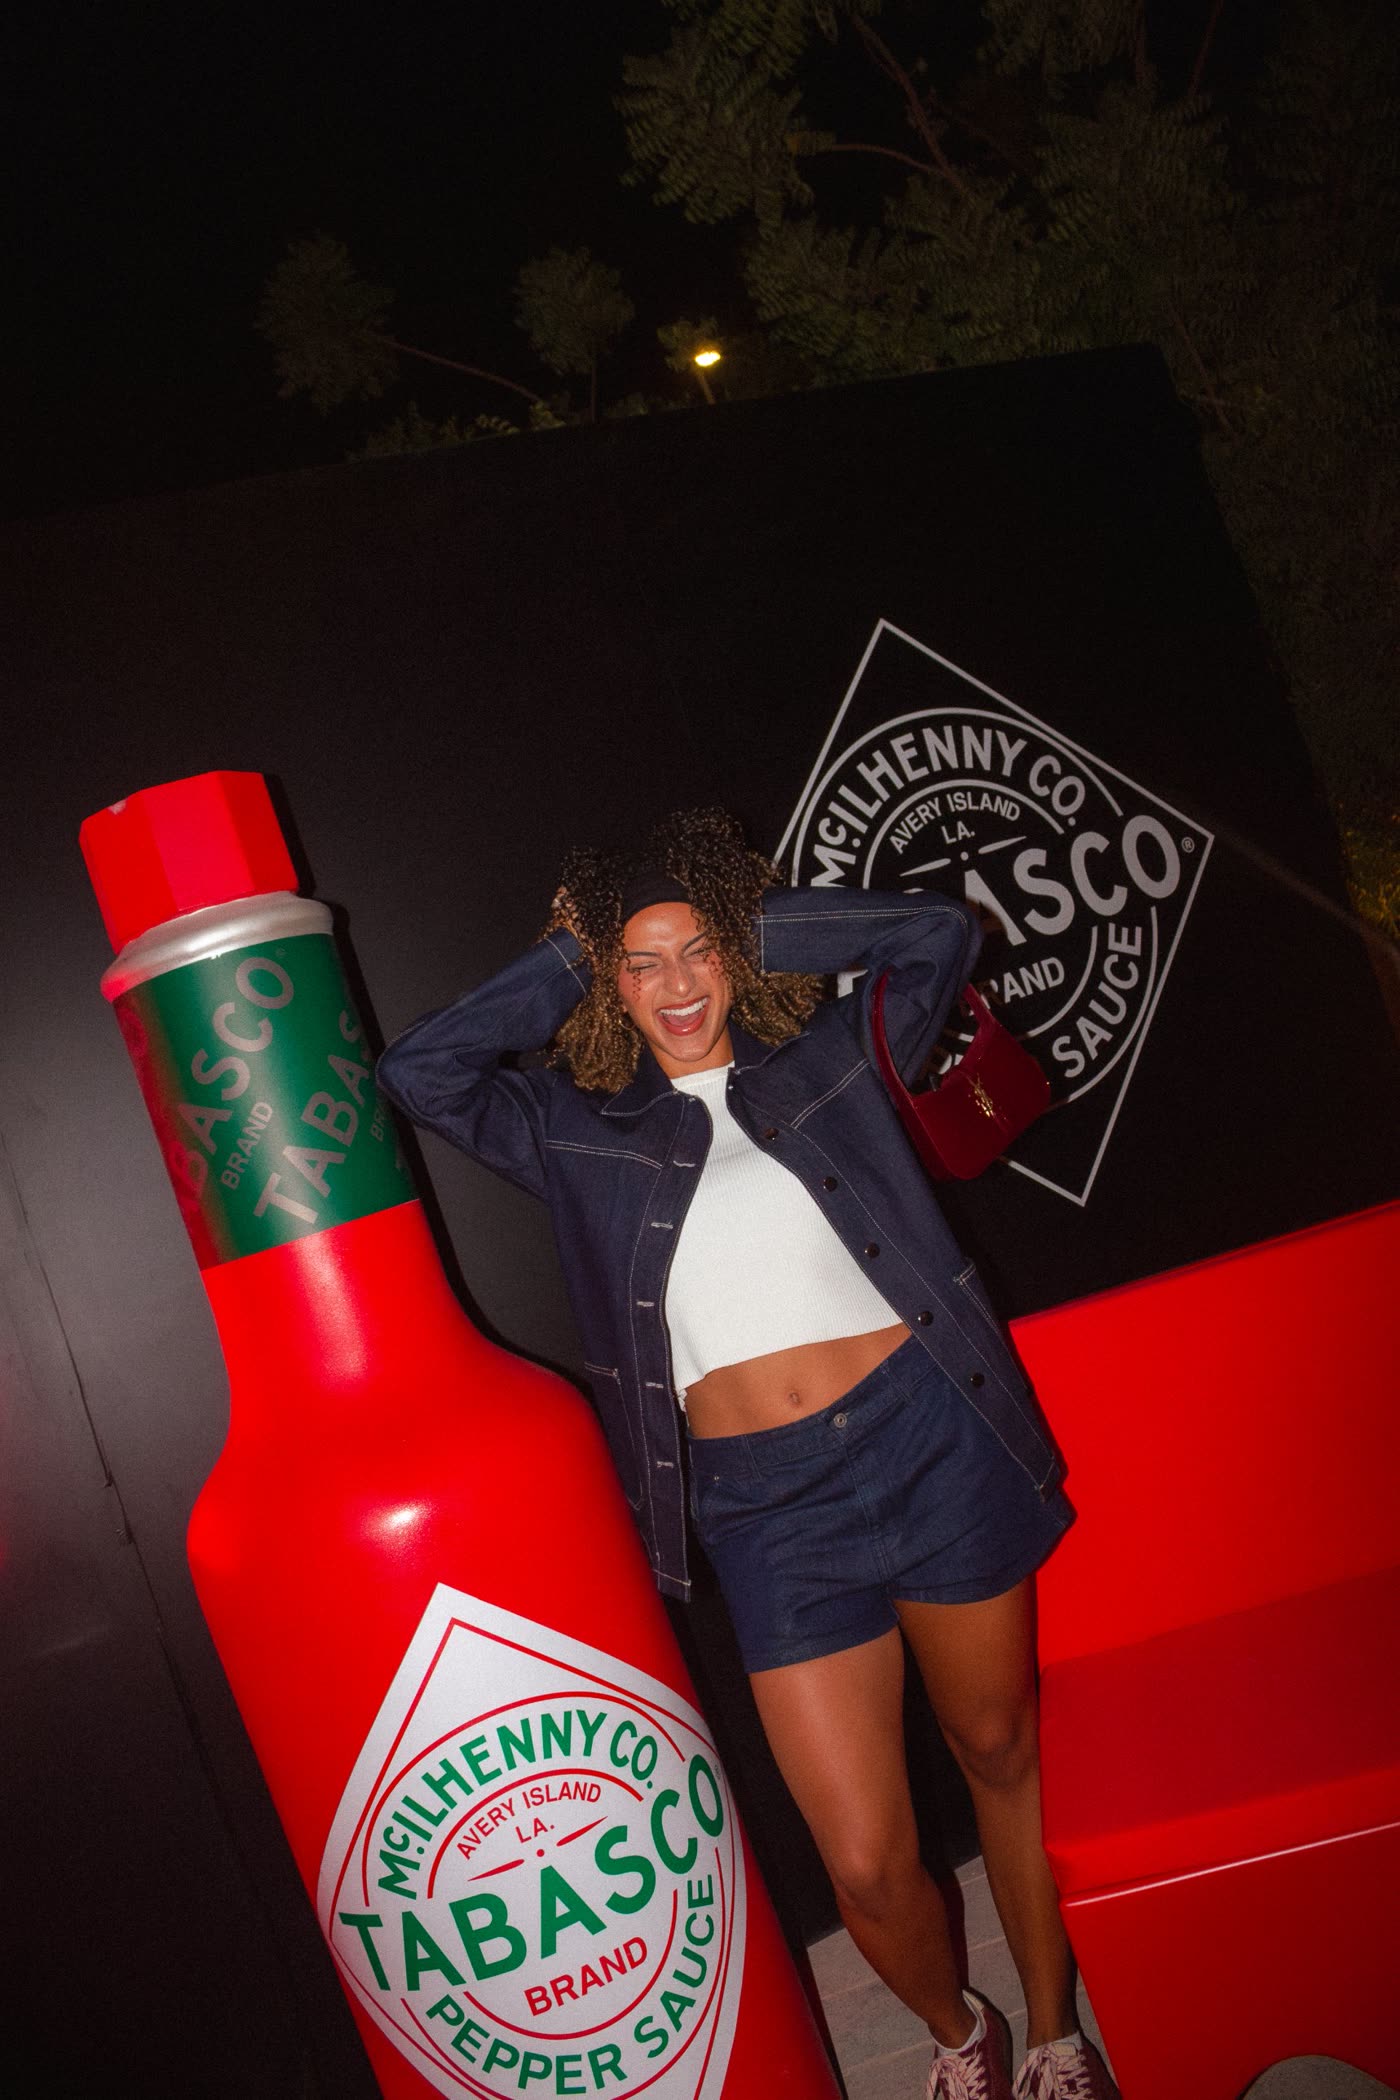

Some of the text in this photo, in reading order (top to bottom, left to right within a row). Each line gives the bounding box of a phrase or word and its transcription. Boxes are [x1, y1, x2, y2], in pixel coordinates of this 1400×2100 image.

[889, 792, 1020, 854] AVERY ISLAND
[1028, 755, 1085, 826] CO.
[941, 821, 975, 844] LA.
[990, 956, 1065, 1004] AND
[1052, 923, 1142, 1079] SAUCE
[221, 1101, 273, 1190] BRAND
[610, 1720, 658, 1788] CO.
[457, 1781, 602, 1860] AVERY ISLAND
[515, 1818, 555, 1844] LA.
[339, 1754, 724, 1991] TABASCO
[426, 1874, 714, 2096] PEPPER SAUCE
[524, 1936, 648, 2017] BRAND
